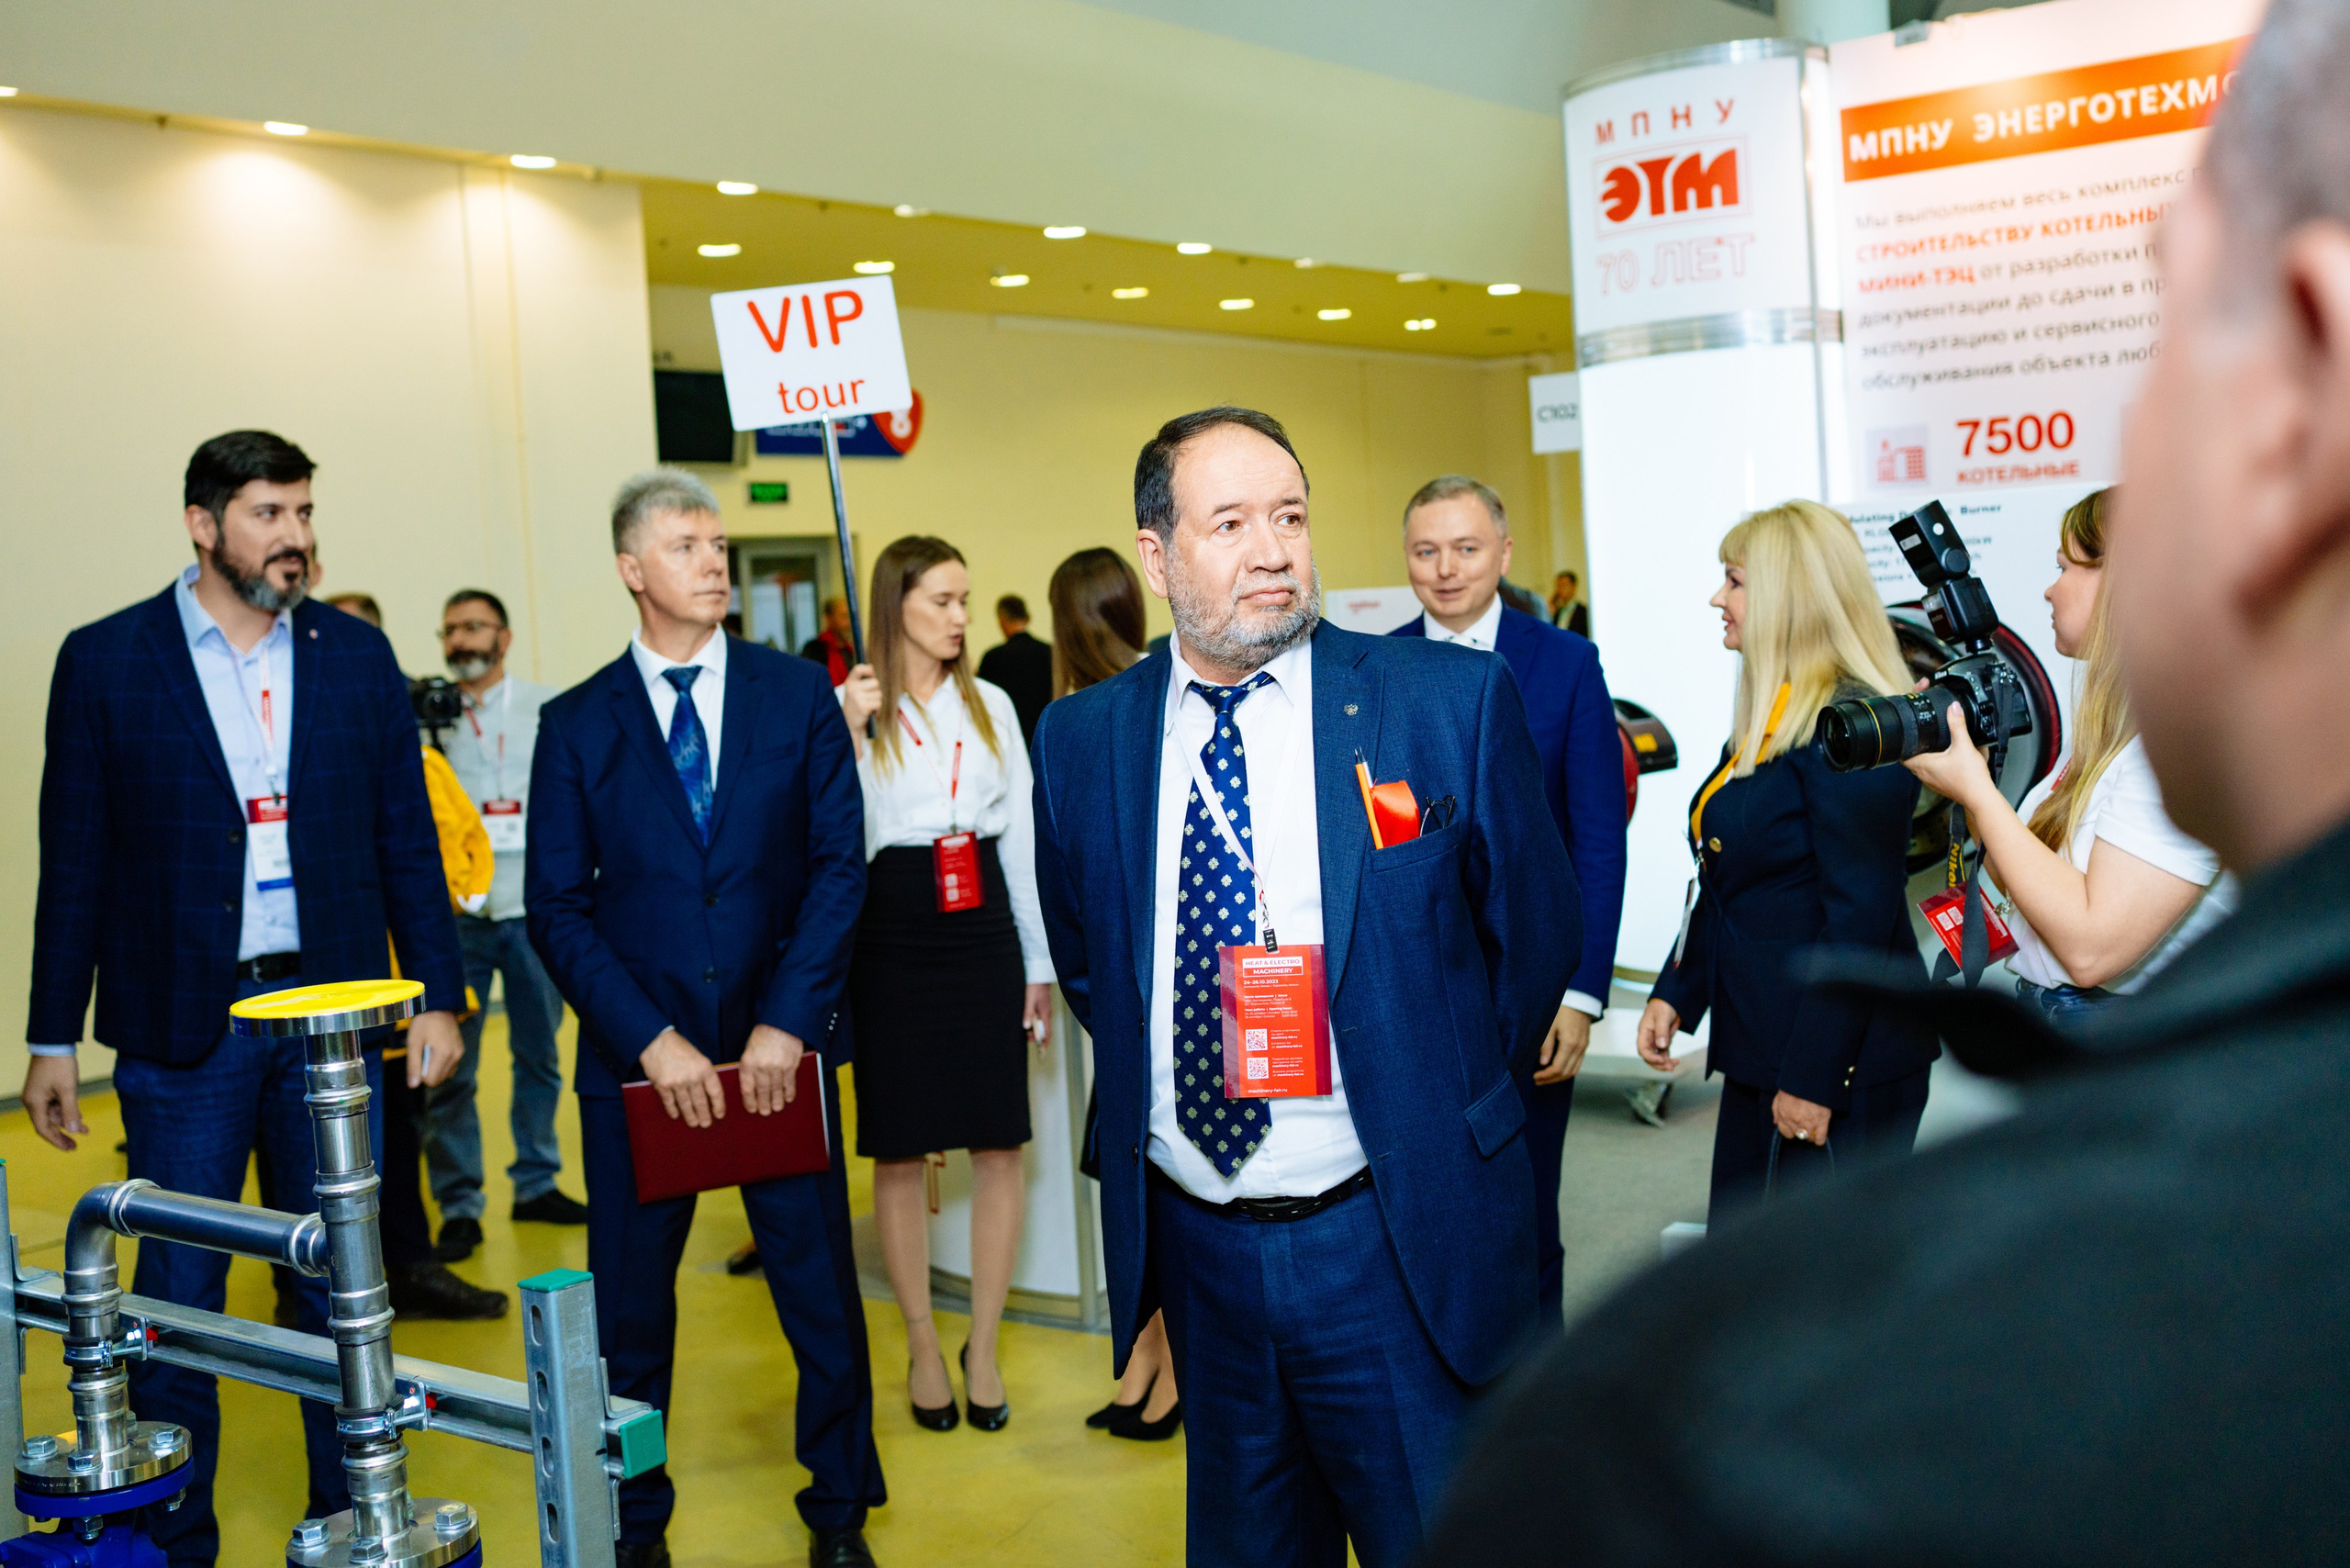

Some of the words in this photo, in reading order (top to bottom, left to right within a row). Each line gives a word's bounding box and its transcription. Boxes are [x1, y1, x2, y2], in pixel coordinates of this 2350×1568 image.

[1595, 97, 1734, 144] МПНУ
[1849, 119, 1953, 162] МПНУ
[1600, 148, 1740, 223] ЭТМ
[1895, 196, 2016, 225] выполняем
[2022, 189, 2071, 207] весь
[2077, 169, 2185, 199] комплекс
[1857, 222, 2034, 263] СТРОИТЕЛЬСТВУ
[2041, 201, 2172, 240] КОТЕЛЬНЫ
[1595, 248, 1640, 297] 70
[1650, 231, 1756, 288] ЛЕТ
[1858, 264, 1976, 294] МИНИ-ТЭЦ
[1980, 263, 2003, 280] от
[2009, 245, 2138, 280] разработки
[746, 289, 864, 353] VIP
[1858, 296, 2011, 330] документации
[2018, 292, 2044, 310] до
[2049, 283, 2113, 306] сдачи
[2121, 279, 2135, 297] в
[1862, 330, 2008, 359] эксплуатацию
[2013, 330, 2027, 343] и
[2032, 311, 2160, 343] сервисного
[1861, 361, 2013, 392] обслуживания
[2020, 349, 2109, 376] объекта
[2116, 339, 2164, 366] люб
[778, 379, 866, 415] tour
[1956, 410, 2076, 457] 7500
[1957, 460, 2080, 484] КОТЕЛЬНЫЕ
